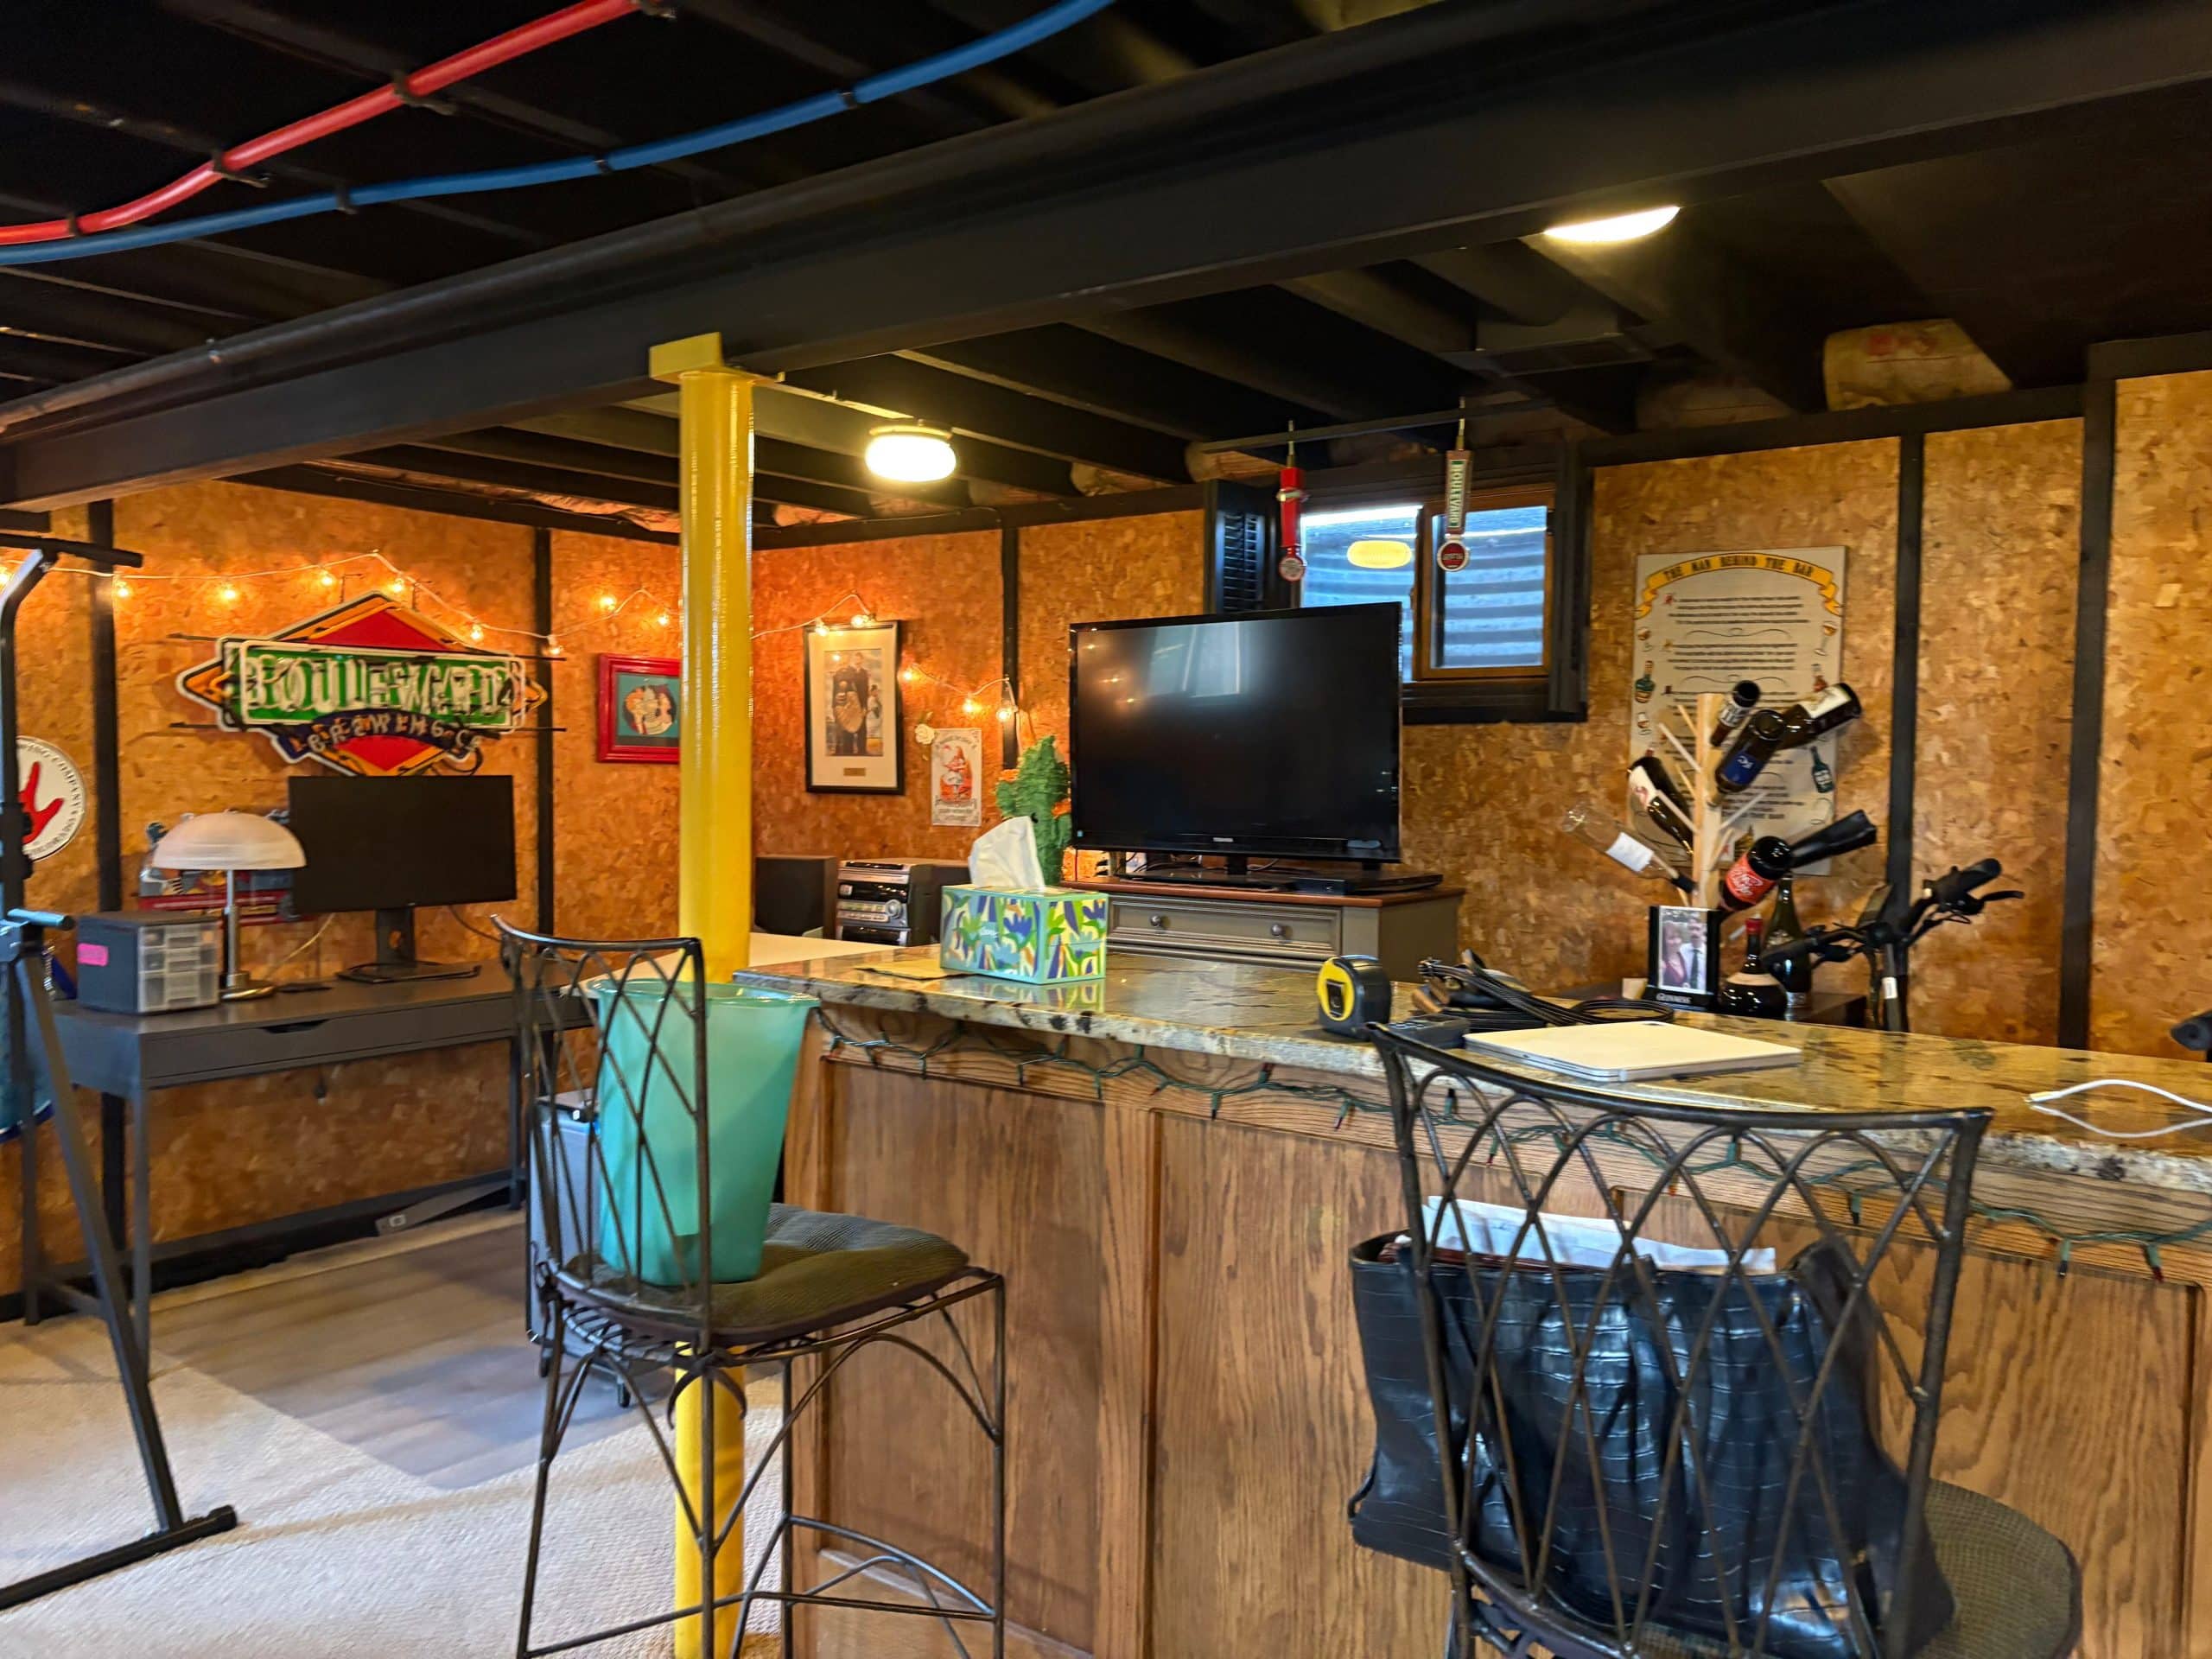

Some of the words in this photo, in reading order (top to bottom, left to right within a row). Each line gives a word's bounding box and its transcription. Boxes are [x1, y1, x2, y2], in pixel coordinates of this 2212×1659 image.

[1663, 567, 1683, 581] THE
[1766, 557, 1785, 569] THE
[245, 654, 514, 716] BOULEVARD
